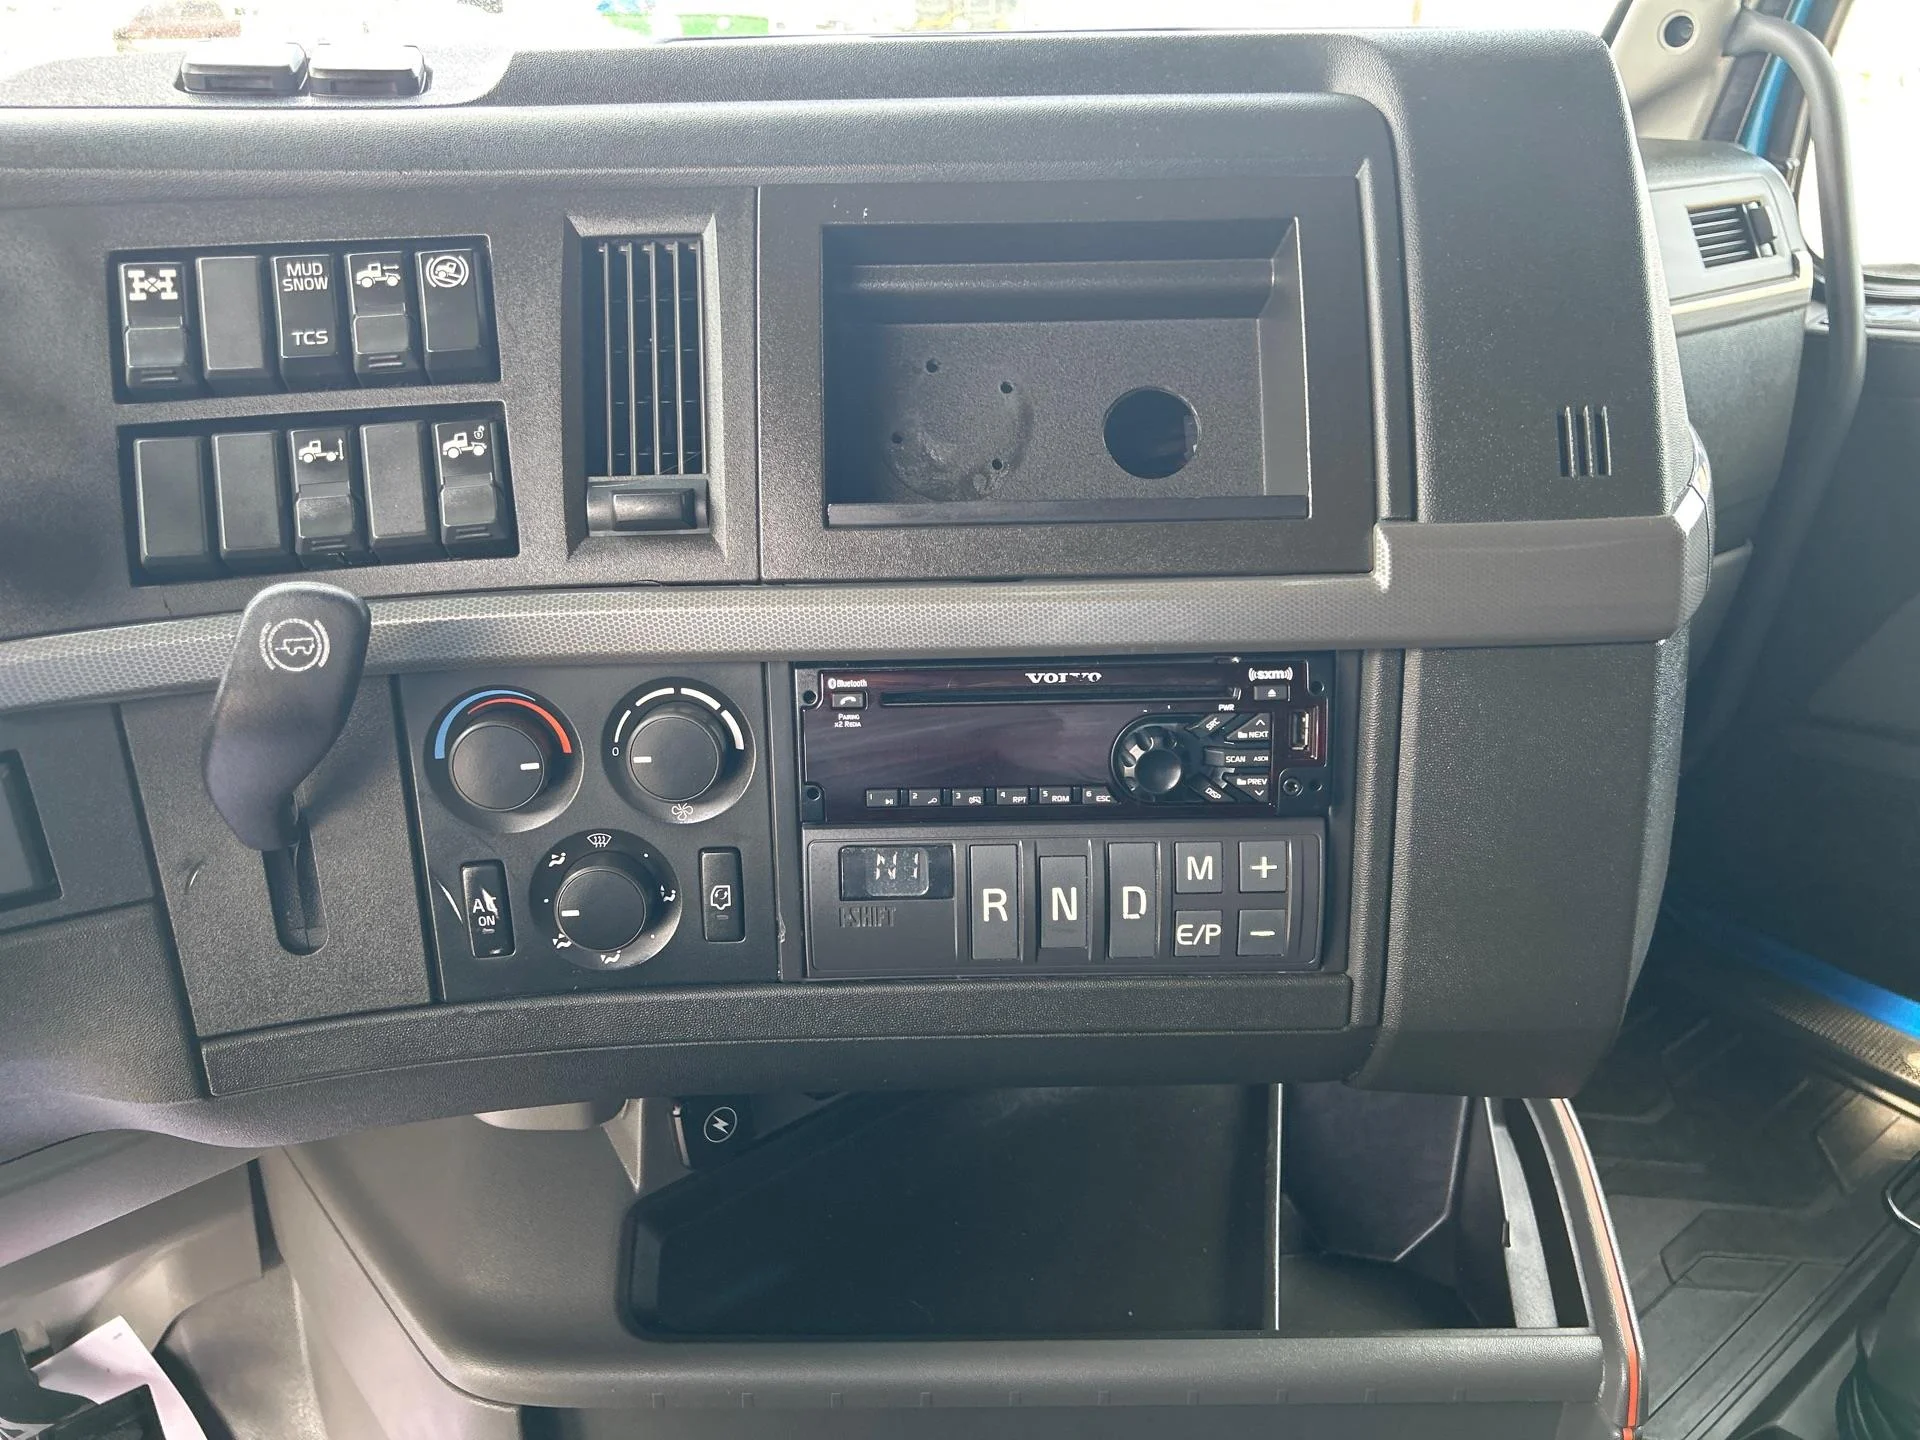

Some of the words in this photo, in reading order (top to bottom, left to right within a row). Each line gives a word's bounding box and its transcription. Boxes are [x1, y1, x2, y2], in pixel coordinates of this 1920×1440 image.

[286, 263, 323, 277] MUD
[283, 277, 329, 291] SNOW
[291, 330, 329, 346] TCS
[836, 679, 868, 688] Bluetooth
[1218, 703, 1235, 712] PWR
[1205, 717, 1221, 731] SRC
[1248, 730, 1269, 739] NEXT
[1225, 755, 1246, 763] SCAN
[1204, 786, 1222, 799] DISP
[1012, 796, 1027, 804] RPT
[1187, 855, 1214, 880] M
[983, 888, 1008, 922] R
[1052, 887, 1078, 921] N
[1122, 886, 1147, 920] D
[478, 915, 496, 927] ON
[1176, 923, 1221, 946] E/P
